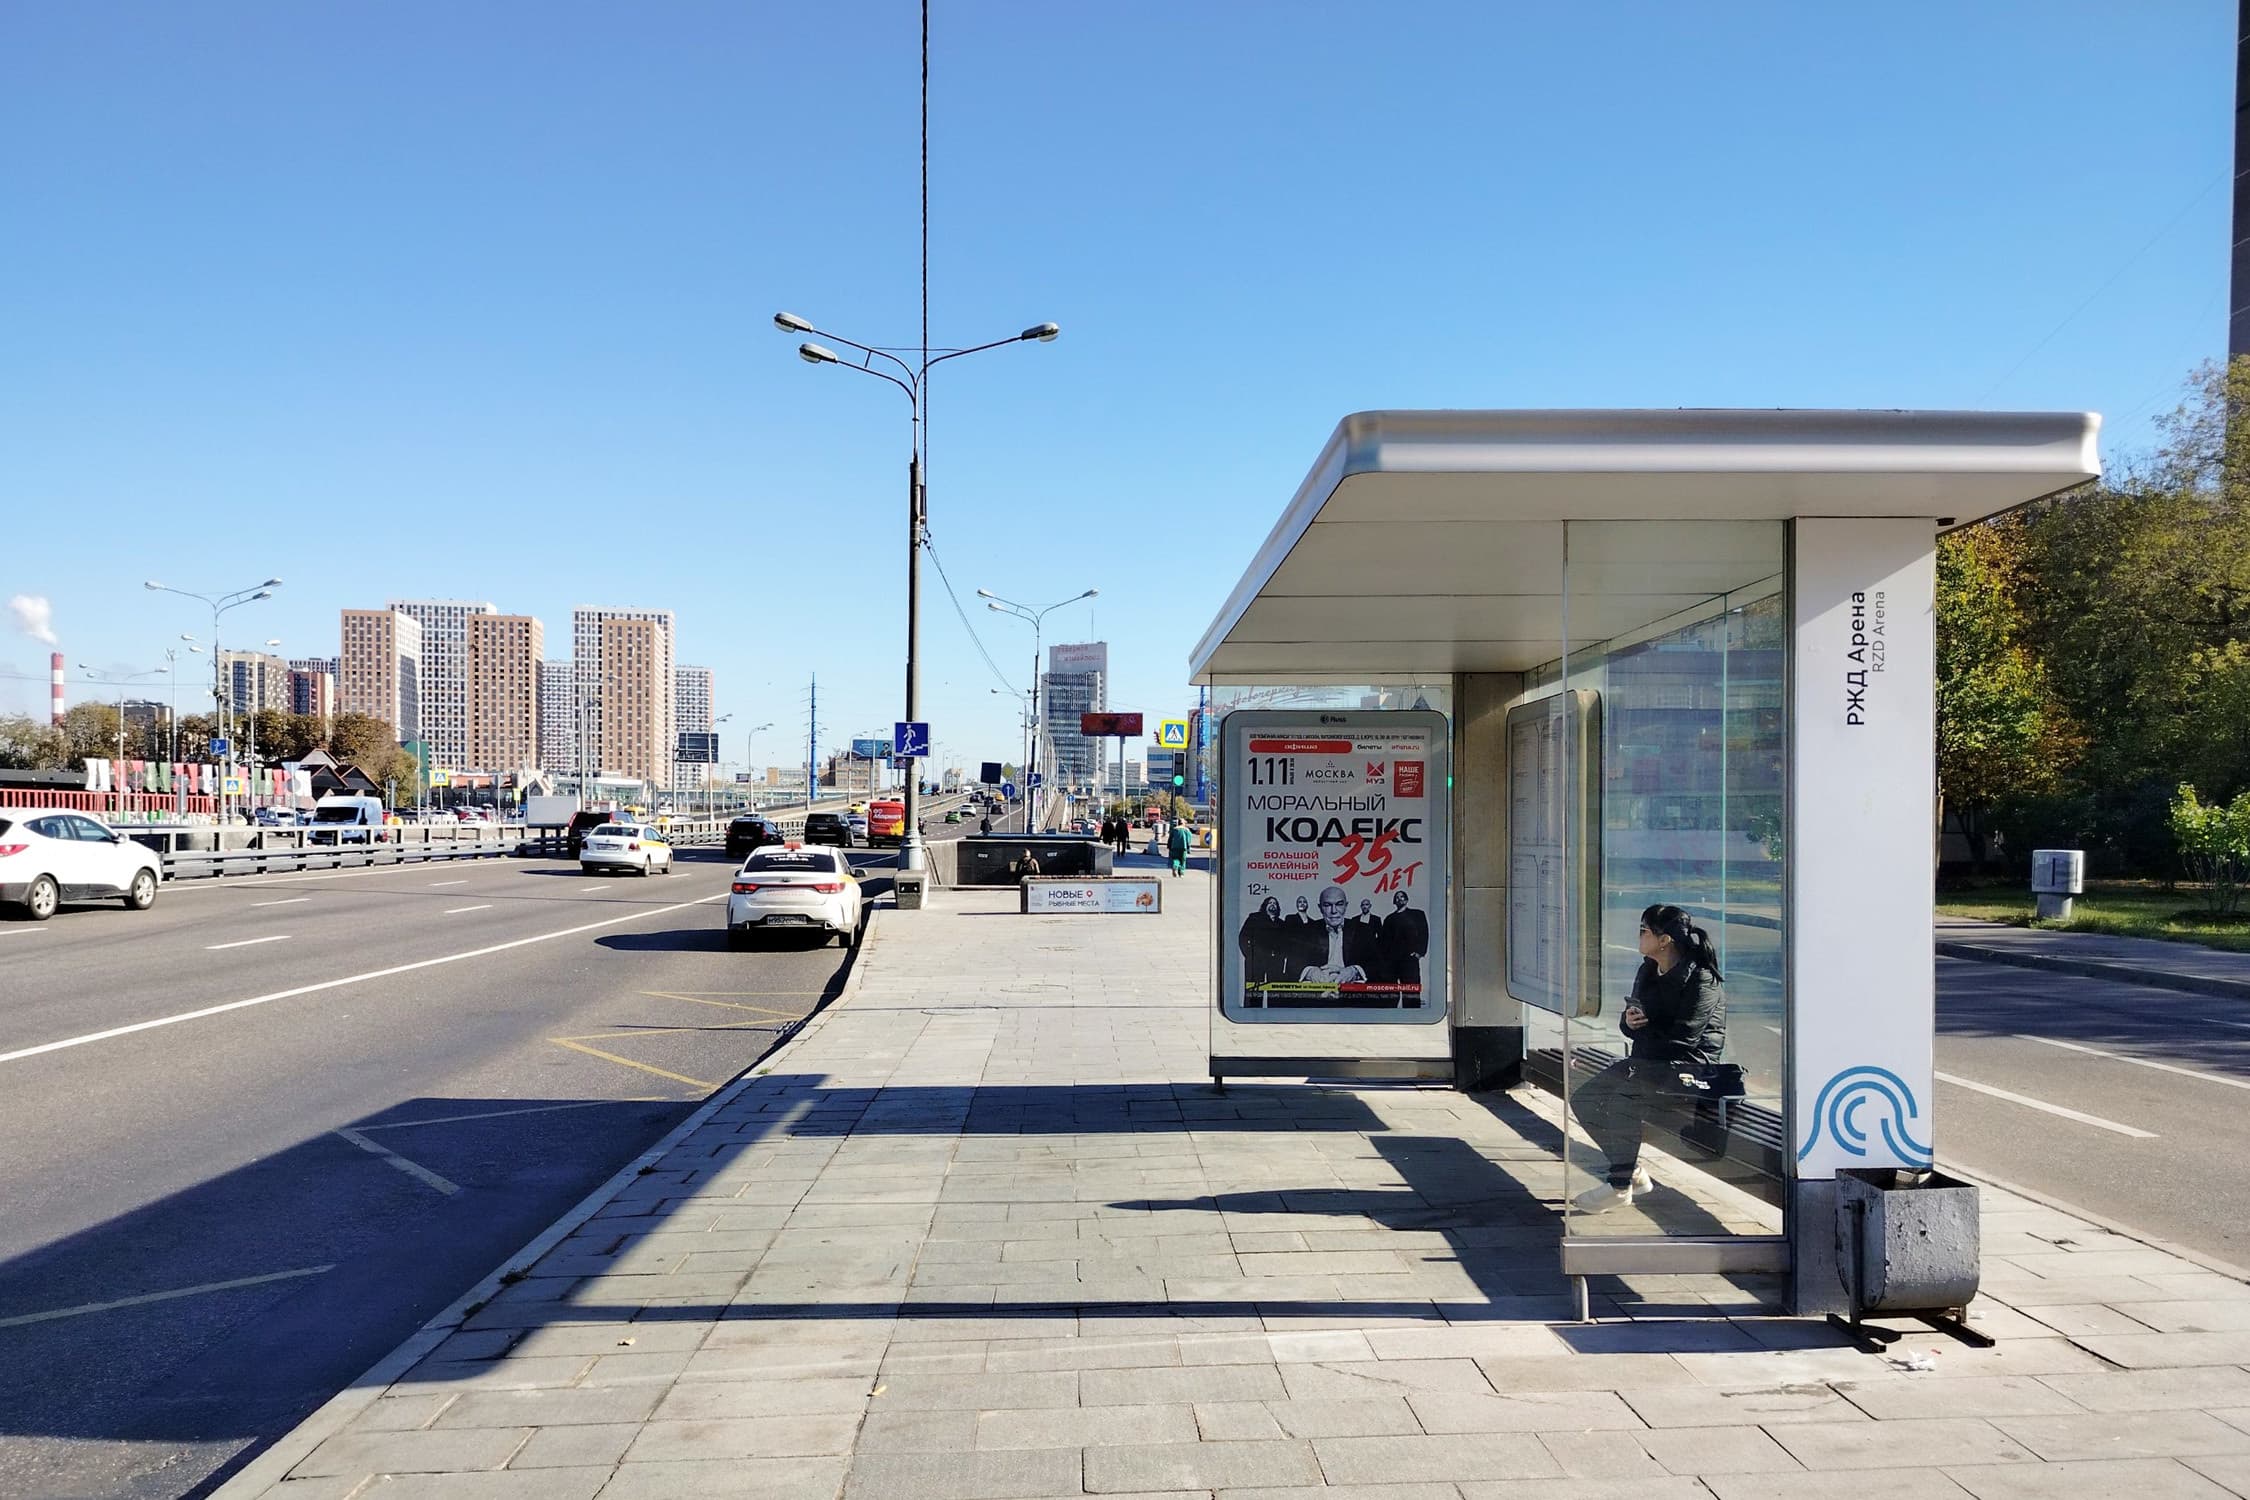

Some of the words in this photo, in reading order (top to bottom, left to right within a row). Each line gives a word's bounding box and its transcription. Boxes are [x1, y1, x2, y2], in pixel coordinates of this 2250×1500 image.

[1872, 591, 1885, 636] Arena
[1847, 591, 1869, 663] Арена
[1872, 640, 1885, 672] RZD
[1847, 669, 1868, 725] РЖД
[1248, 757, 1288, 785] 1.11
[1305, 769, 1355, 779] МОСКВА
[1399, 766, 1420, 774] НАШЕ
[1247, 794, 1386, 811] МОРАЛЬНЫЙ
[1266, 816, 1422, 848] КОДЕКС
[1247, 861, 1319, 870] ЮБИЛЕЙНЫЙ
[1264, 851, 1319, 860] БОЛЬШОЙ
[1332, 828, 1400, 885] 35
[1268, 872, 1319, 881] КОНЦЕРТ
[1374, 861, 1423, 894] ЛЕТ
[1048, 890, 1084, 899] НОВЫЕ
[1247, 883, 1270, 895] 12+
